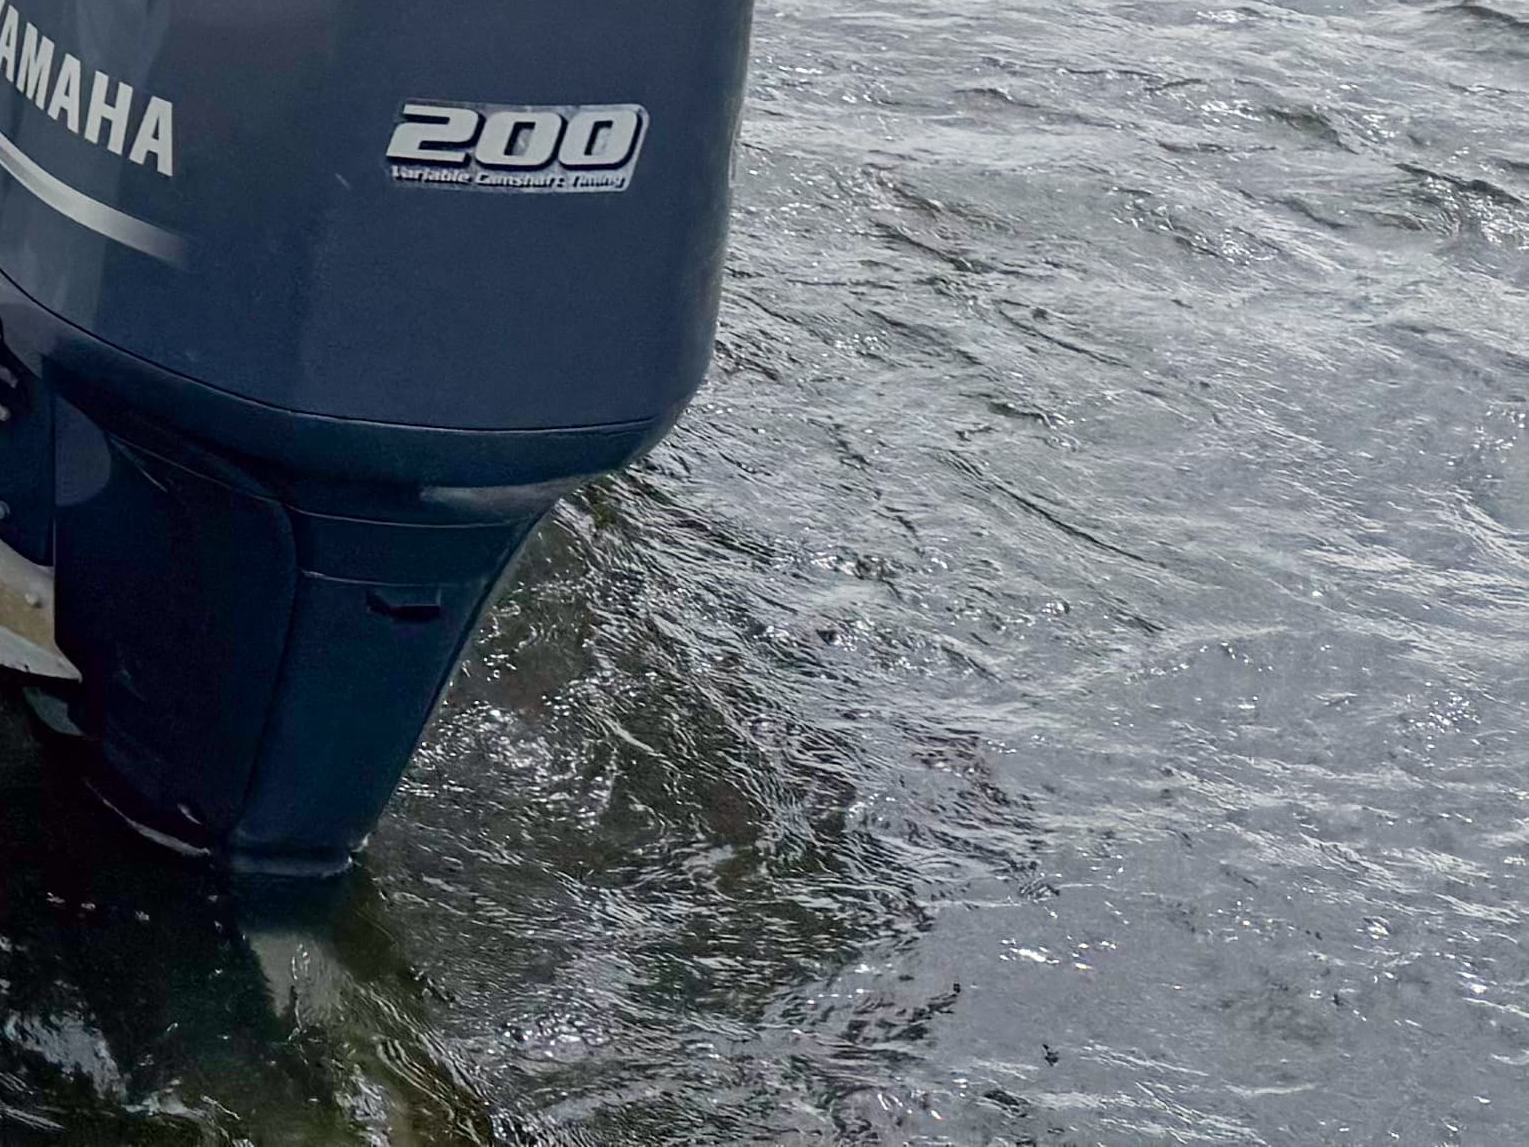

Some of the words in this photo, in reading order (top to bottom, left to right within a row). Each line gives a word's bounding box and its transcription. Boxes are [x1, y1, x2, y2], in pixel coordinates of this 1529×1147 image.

[386, 103, 642, 170] 200
[391, 165, 471, 183] Variable
[475, 171, 565, 188] Camshaft
[570, 173, 626, 189] Timing
